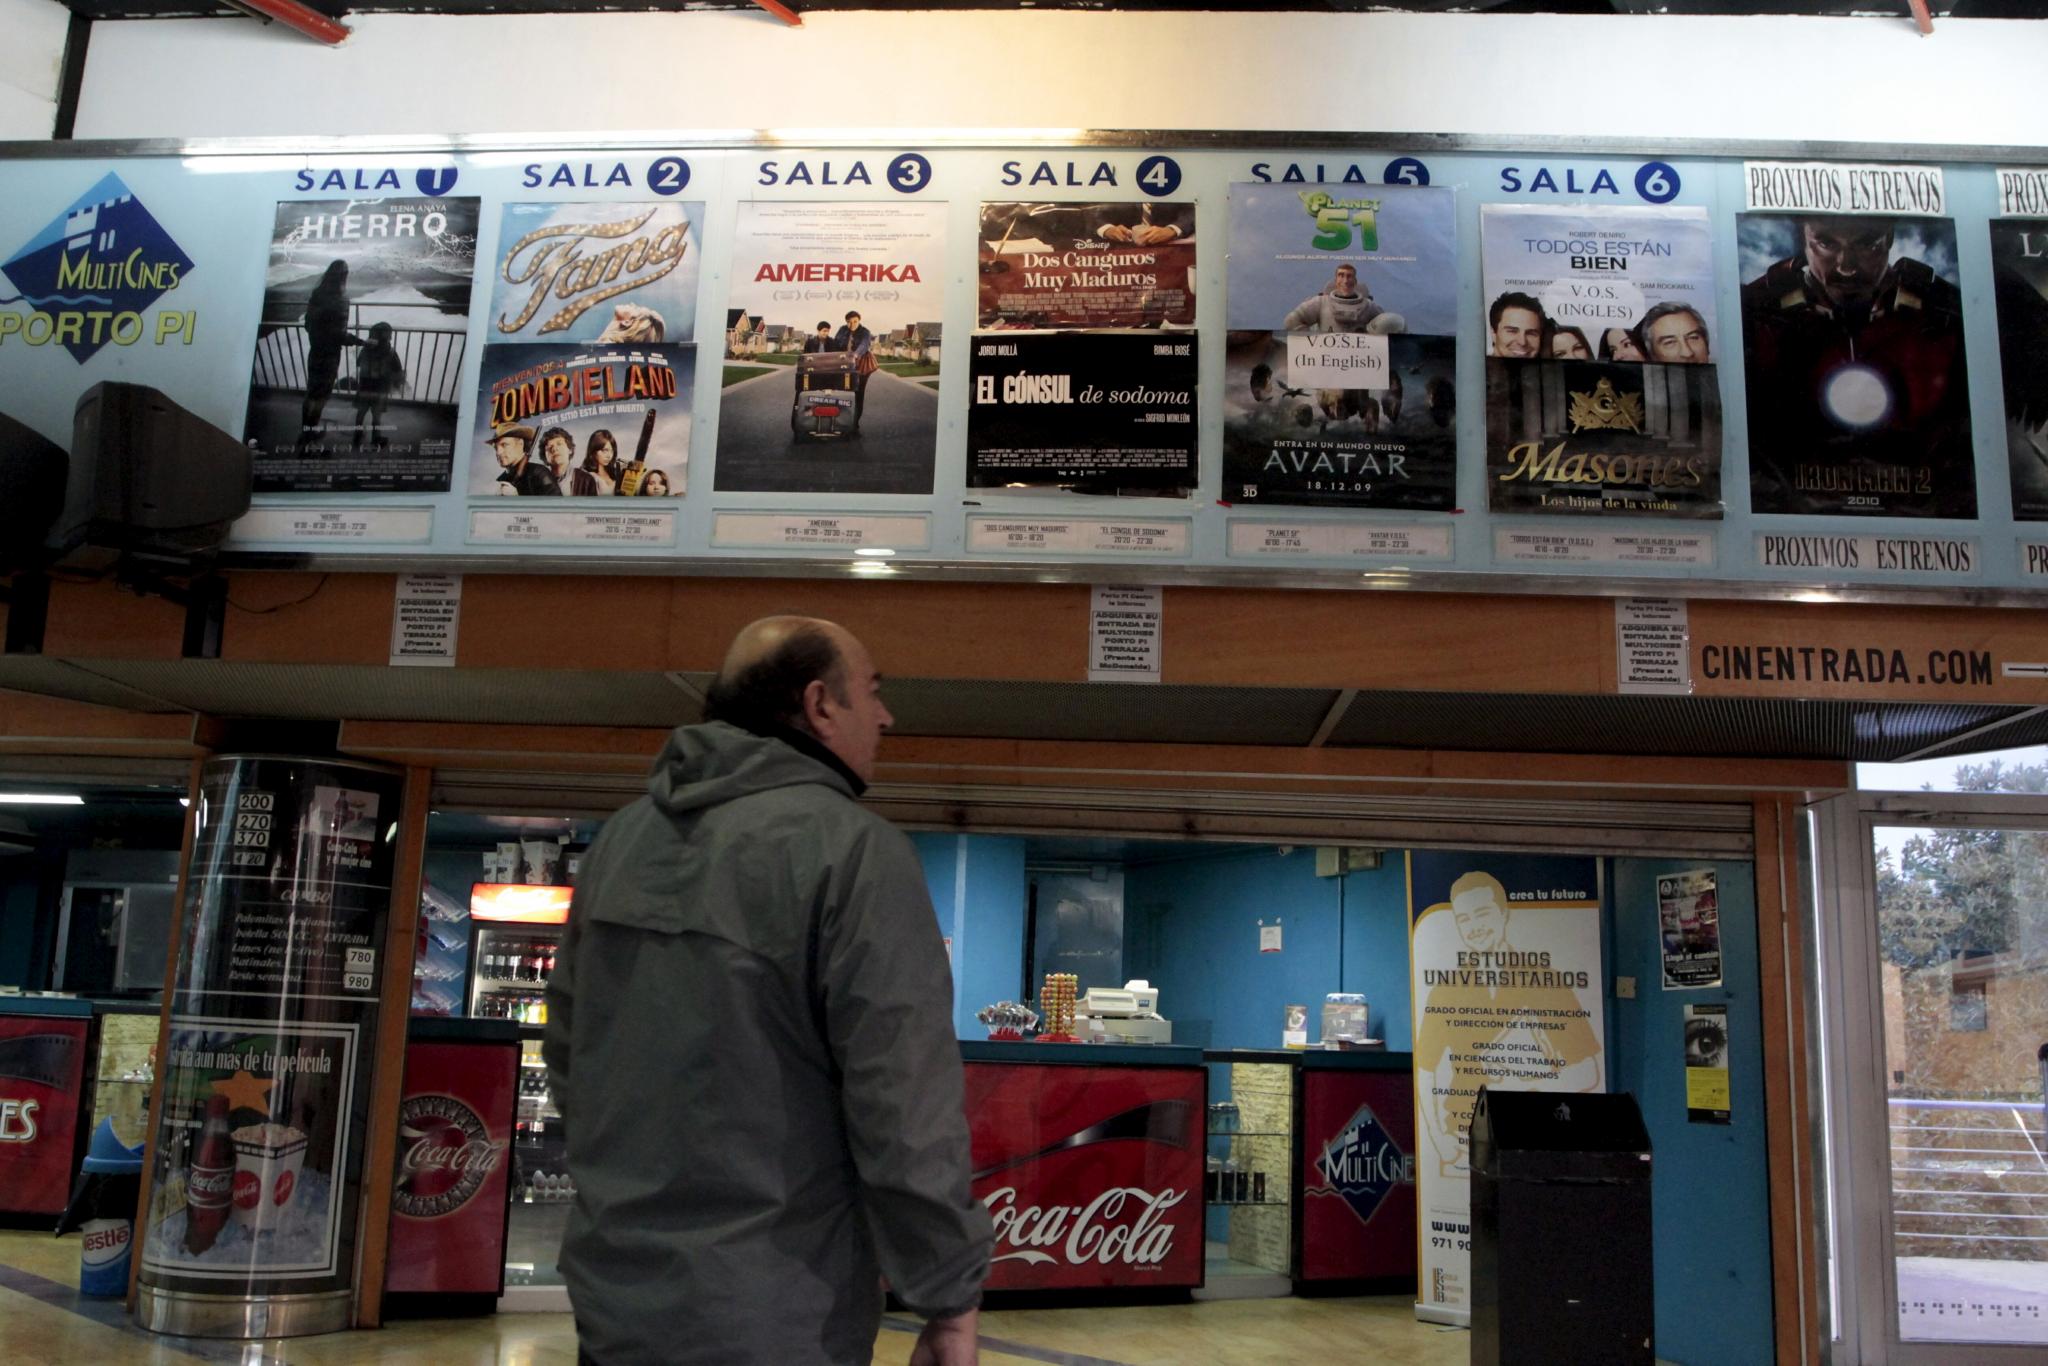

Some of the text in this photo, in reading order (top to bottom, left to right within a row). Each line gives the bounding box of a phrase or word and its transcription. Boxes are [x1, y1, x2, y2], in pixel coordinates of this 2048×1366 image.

[295, 168, 401, 192] SALA
[522, 163, 633, 188] SALA
[758, 160, 873, 186] SALA
[1001, 161, 1118, 187] SALA
[1500, 167, 1620, 194] SALA
[1750, 166, 1942, 213] PROXIMOS ESTRENOS
[1310, 191, 1382, 211] PLANET
[302, 212, 448, 240] HIERRO
[1312, 208, 1380, 252] 51
[1523, 239, 1672, 257] TODOS ESTÁN
[1023, 252, 1156, 271] Dos Canguros
[1570, 256, 1627, 271] BIEN
[497, 208, 692, 336] Fama
[754, 263, 921, 283] AMERRIKA
[1023, 271, 1157, 292] Muy Maduros
[1570, 284, 1619, 300] V.O.S.
[1557, 303, 1633, 321] (INGLES)
[0, 311, 197, 346] PORTO PI
[978, 345, 997, 357] JORDI
[1153, 344, 1174, 356] BIMBA
[1306, 335, 1371, 350] V.O.S.E.
[1295, 354, 1383, 372] (In English)
[489, 364, 678, 429] ZOMBIELAND
[977, 370, 1190, 405] EL CÓNSUL de sodoma
[541, 403, 646, 427] ESTE SITIO ESTÁ MUY MUERTO
[1273, 440, 1406, 452] ENTRA EN UN MUNDO NUEVO
[1263, 450, 1412, 480] AVATAR
[1499, 441, 1702, 488] Masones
[1307, 481, 1372, 492] 18.12.09
[1794, 463, 1933, 494] IRON MAN 2
[1242, 488, 1258, 498] 3D
[1847, 495, 1880, 506] 2010
[1541, 495, 1678, 512] Los hijos de la viuda
[1764, 535, 1971, 572] PROXIMOS ESTRENOS
[1702, 644, 1993, 686] CINENTRADA.COM
[241, 795, 270, 809] 200
[239, 815, 269, 829] 270
[237, 832, 266, 845] 370
[1509, 889, 1587, 900] crea tu futuro
[350, 951, 371, 963] 780
[1456, 951, 1552, 969] ESTUDIOS
[348, 976, 370, 988] 980
[1423, 969, 1589, 989] UNIVERSITARIOS
[1425, 1006, 1591, 1018] GRADO OFICIAL EN ADMINISTRACIÓN
[1453, 1019, 1504, 1029] DIRECCIÓN
[1506, 1021, 1519, 1029] DE
[1472, 1042, 1543, 1052] GRADO OFICIAL
[216, 1044, 241, 1071] más
[243, 1045, 261, 1072] de
[279, 1047, 332, 1074] película
[1449, 1054, 1567, 1067] EN CIENCIAS DEL TRABAJO
[1455, 1067, 1462, 1075] Y
[1463, 1067, 1511, 1077] RECURSOS
[405, 1138, 506, 1174] Coca-Cola
[1432, 1237, 1452, 1249] 971
